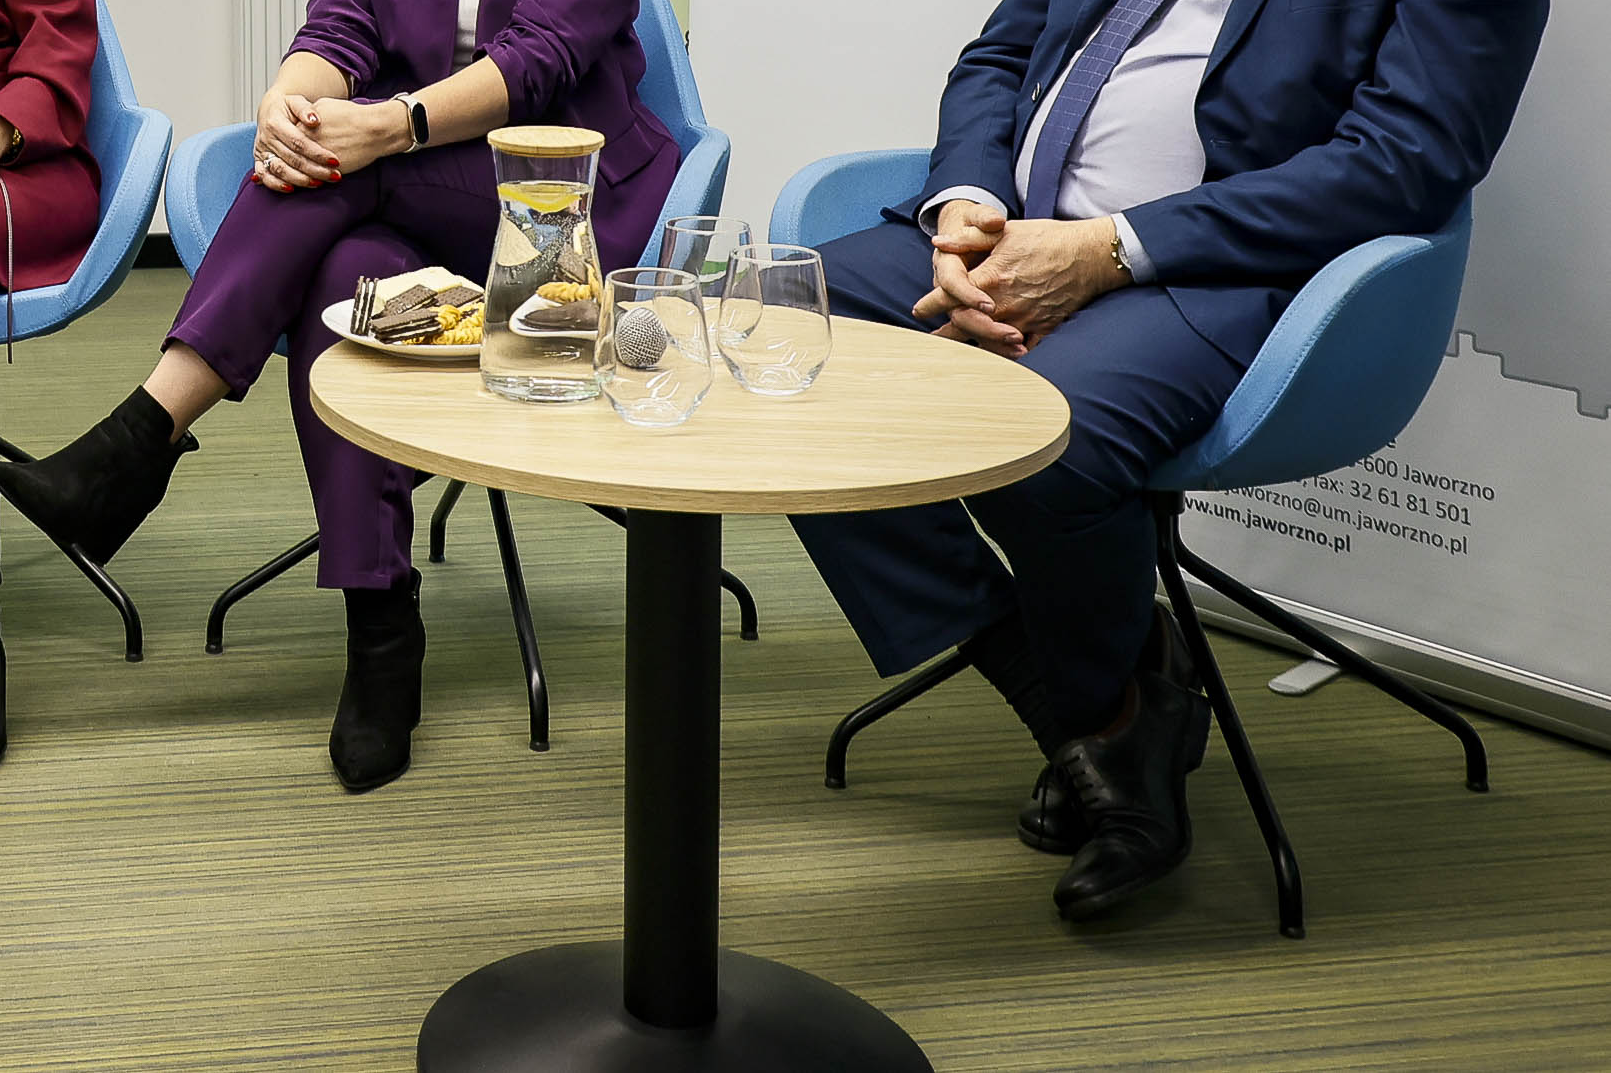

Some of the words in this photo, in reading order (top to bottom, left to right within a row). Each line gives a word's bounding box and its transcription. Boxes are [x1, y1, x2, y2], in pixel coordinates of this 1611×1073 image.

[1349, 479, 1373, 502] 32
[1378, 486, 1401, 509] 61
[1406, 494, 1429, 516] 81
[1435, 500, 1472, 526] 501
[1401, 463, 1495, 502] Jaworzno
